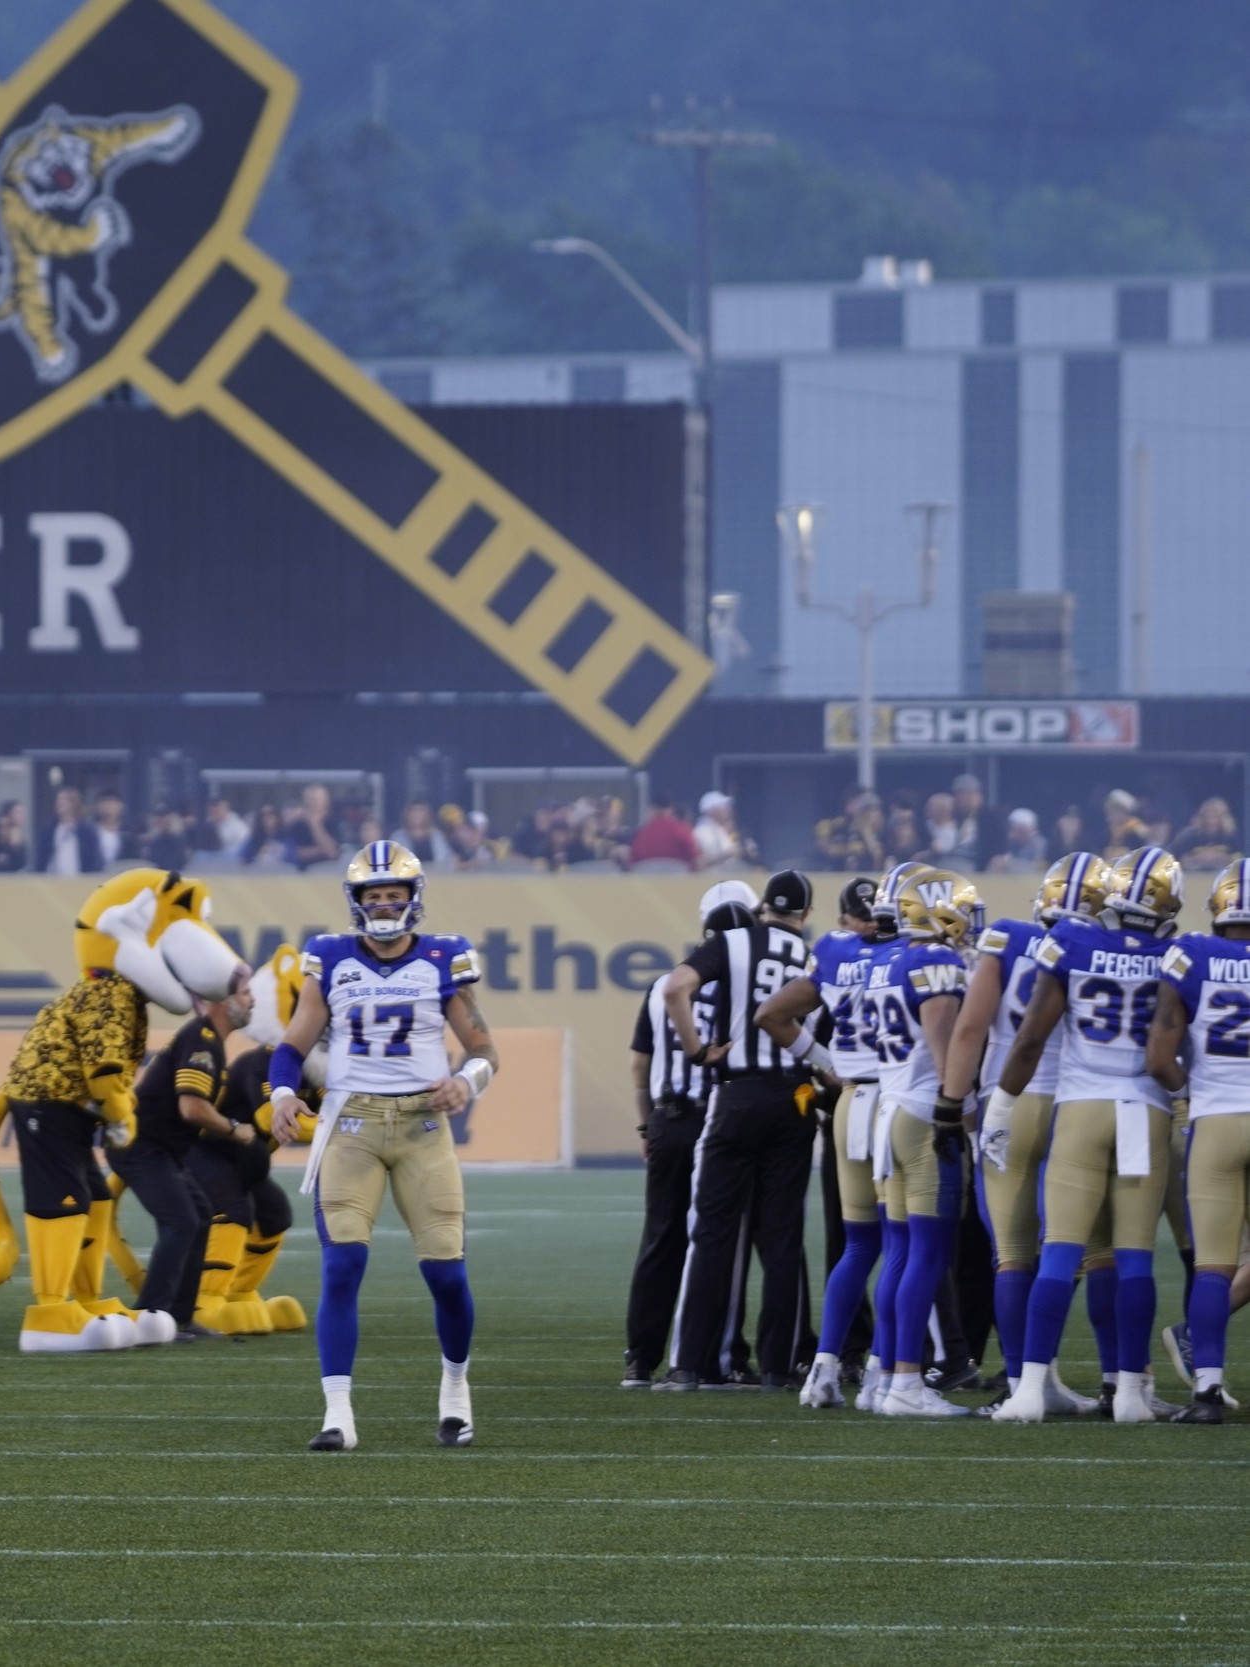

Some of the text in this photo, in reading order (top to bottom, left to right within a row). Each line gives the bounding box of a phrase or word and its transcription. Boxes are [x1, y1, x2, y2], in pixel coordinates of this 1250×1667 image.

[894, 708, 1068, 742] SHOP
[917, 880, 954, 908] W
[348, 987, 421, 997] BLUE BOMBERS
[923, 965, 957, 992] W
[346, 1004, 415, 1057] 17
